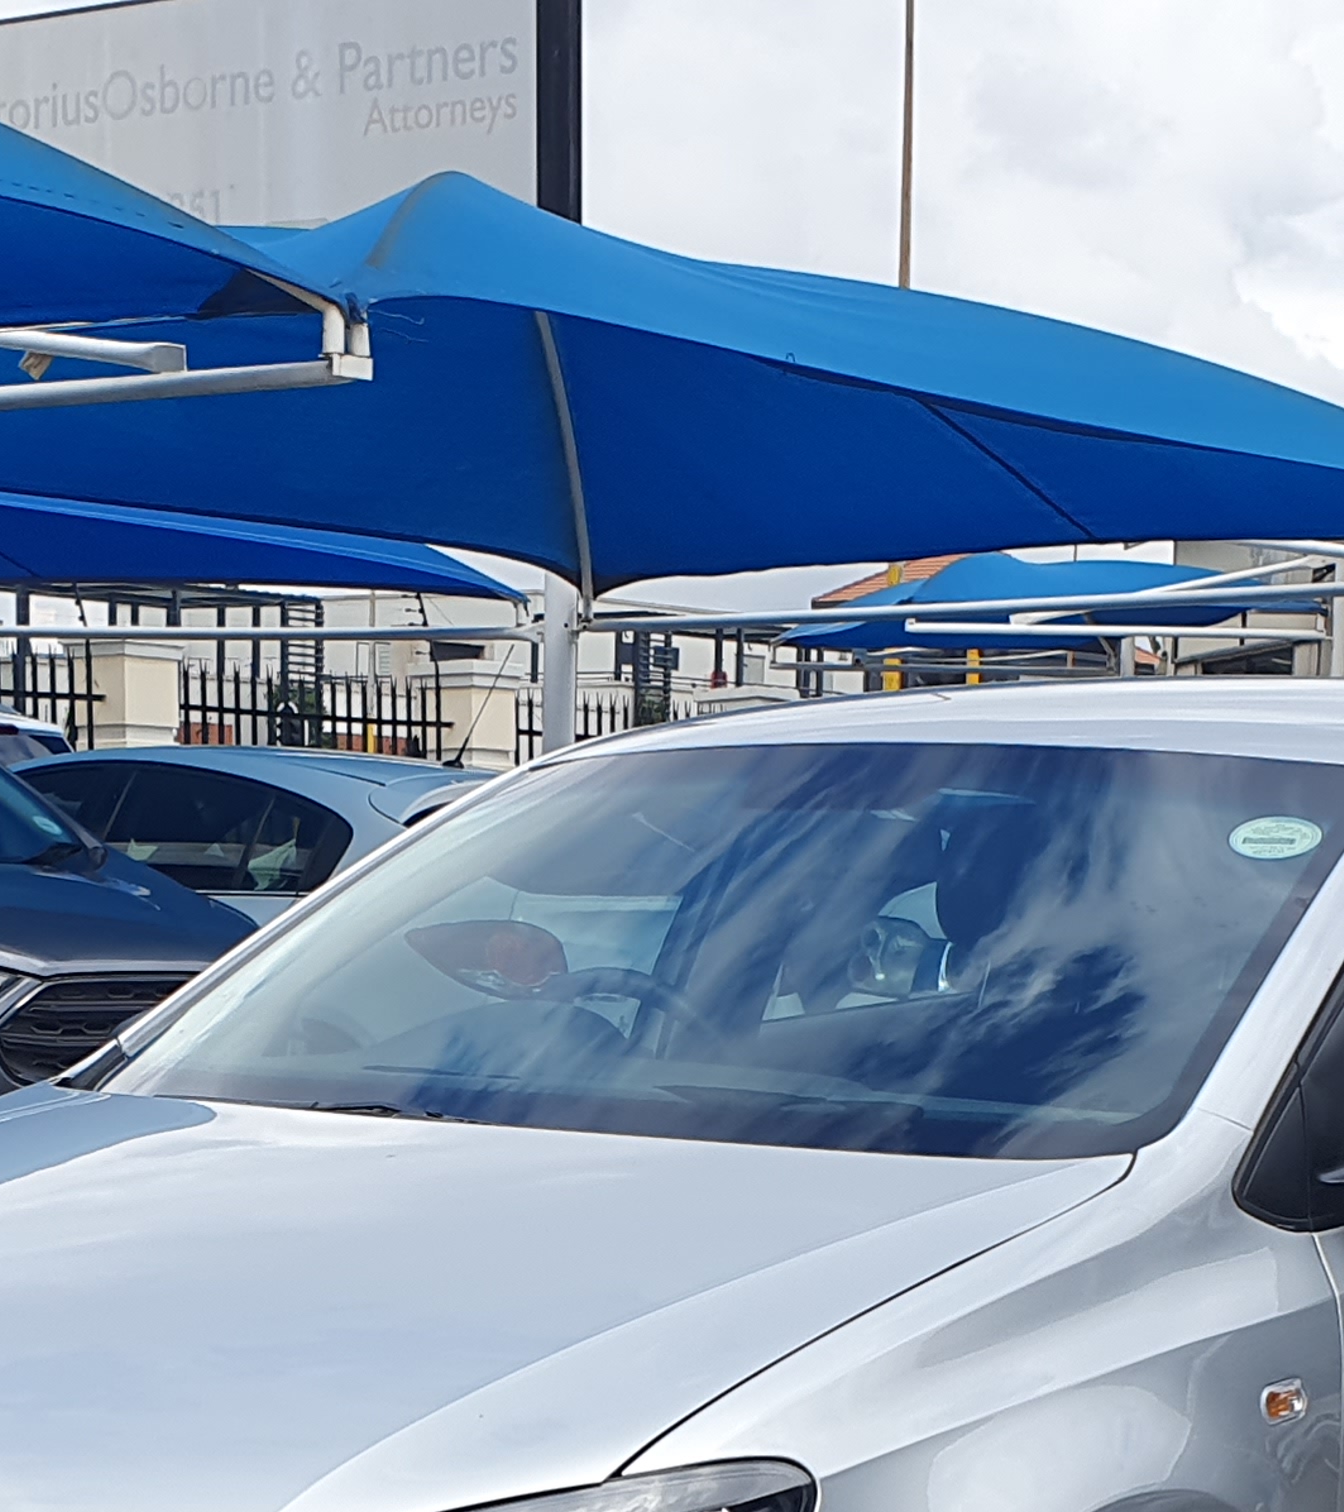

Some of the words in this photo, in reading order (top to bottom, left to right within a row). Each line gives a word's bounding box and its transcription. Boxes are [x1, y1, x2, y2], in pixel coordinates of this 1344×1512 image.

[291, 49, 322, 101] &
[337, 36, 518, 96] Partners
[362, 93, 517, 137] Attorneys
